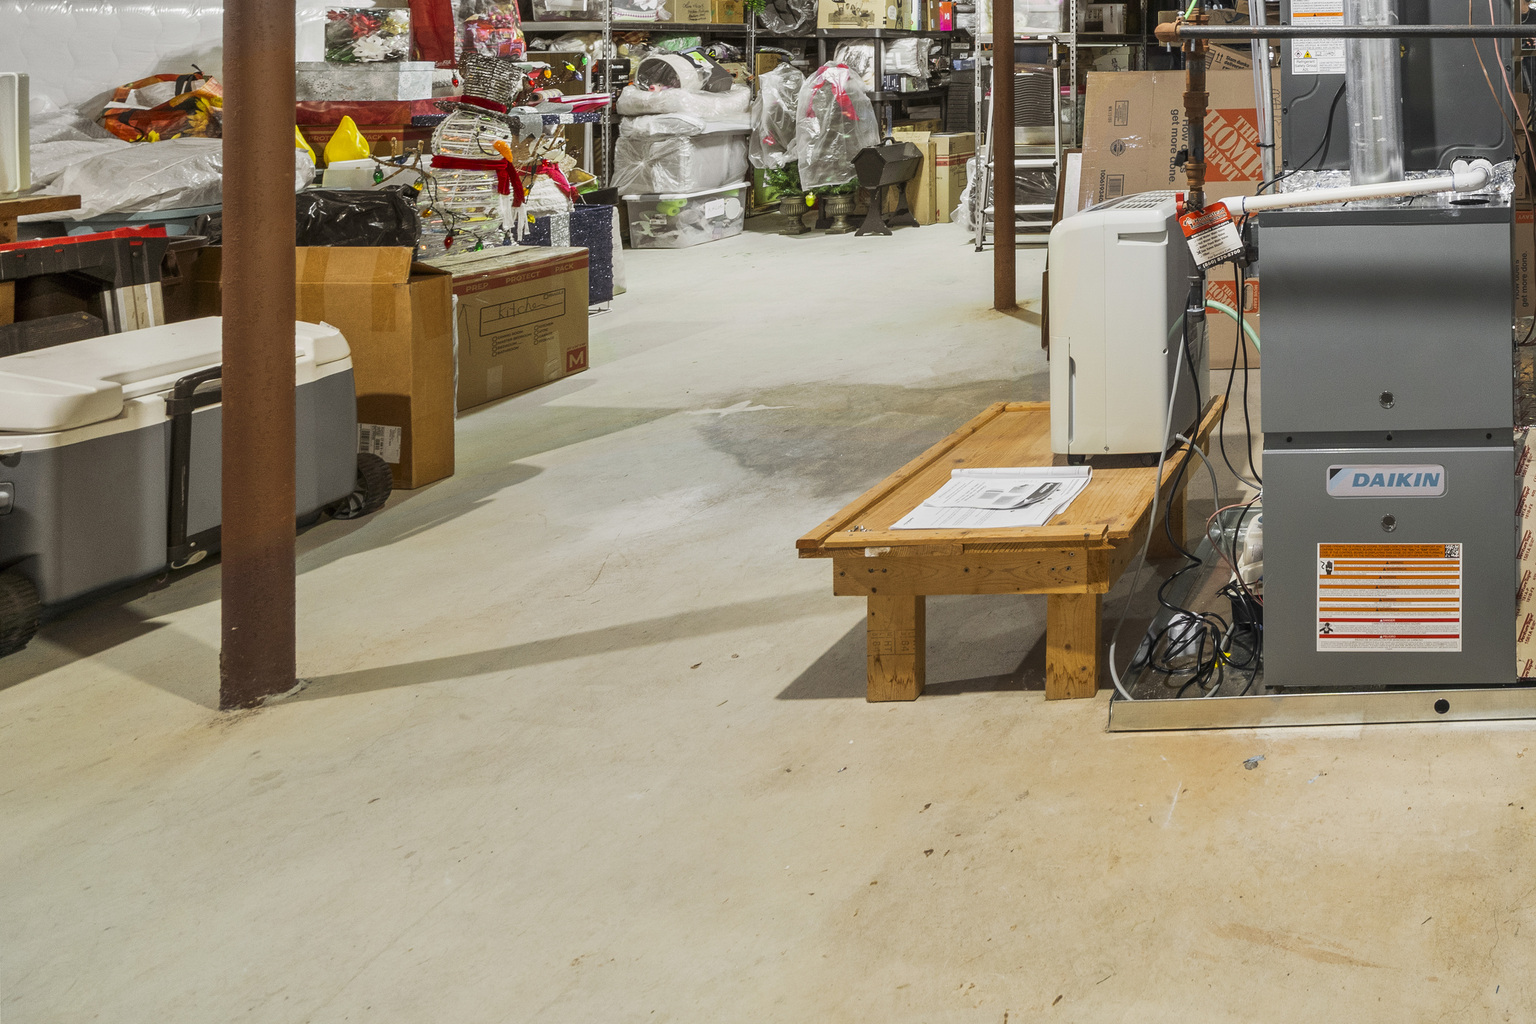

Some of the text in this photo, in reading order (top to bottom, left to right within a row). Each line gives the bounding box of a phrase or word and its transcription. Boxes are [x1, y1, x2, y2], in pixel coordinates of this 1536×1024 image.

[308, 134, 331, 142] PROT
[1204, 108, 1262, 181] HOME
[1234, 115, 1259, 145] THE
[1168, 108, 1179, 185] get more done.
[1204, 137, 1241, 181] DEPOT
[465, 263, 574, 292] PREP PROTECT PACK
[1222, 283, 1234, 297] THE
[568, 350, 584, 369] M
[1351, 472, 1441, 487] DAIKIN
